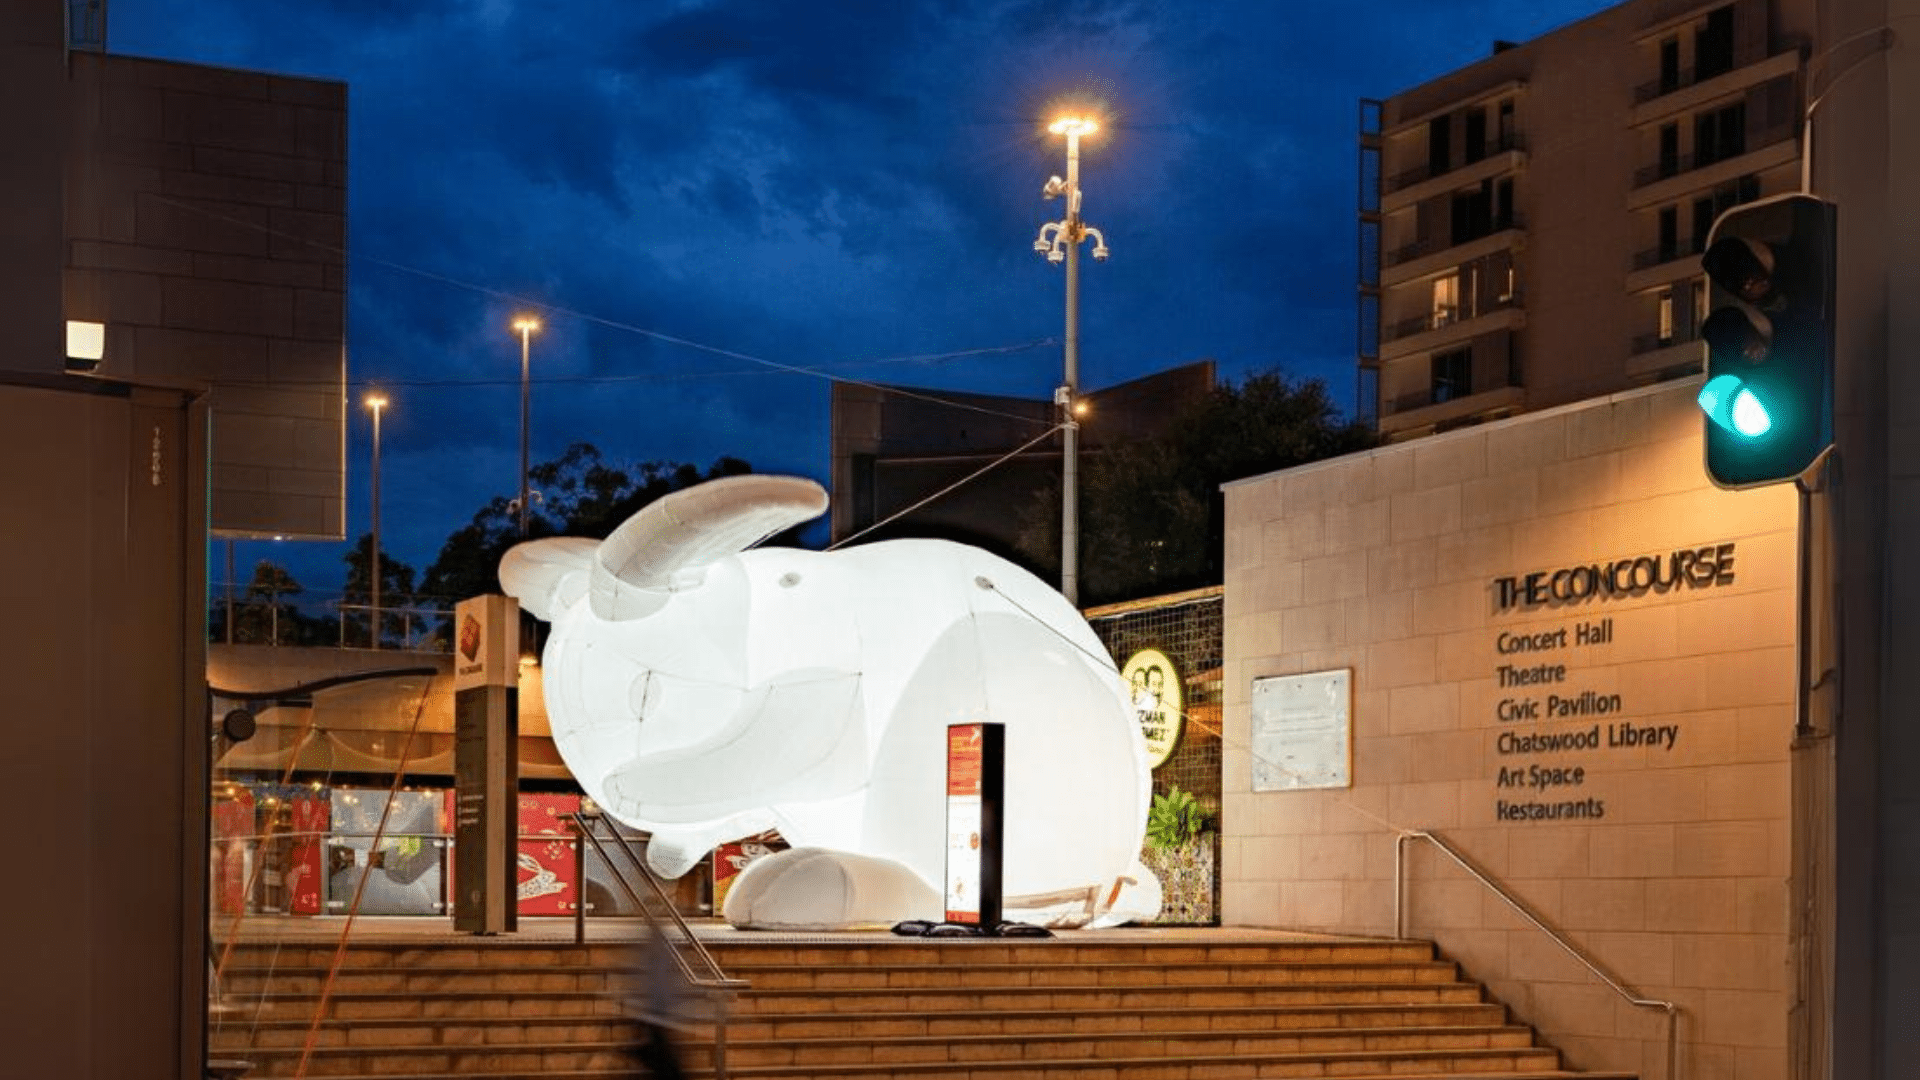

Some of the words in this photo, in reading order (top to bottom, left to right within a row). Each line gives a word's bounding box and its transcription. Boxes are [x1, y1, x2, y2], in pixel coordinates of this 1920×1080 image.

[1497, 627, 1567, 654] Concert
[1575, 618, 1613, 645] Hall
[1497, 664, 1566, 688] Theatre
[1138, 710, 1166, 724] ZMAN
[1497, 699, 1539, 721] Civic
[1547, 691, 1622, 718] Pavilion
[1497, 725, 1599, 754] Chatswood
[1608, 722, 1679, 750] Library
[1497, 766, 1525, 787] Art
[1529, 765, 1584, 791] Space
[1497, 798, 1605, 821] Restaurants
